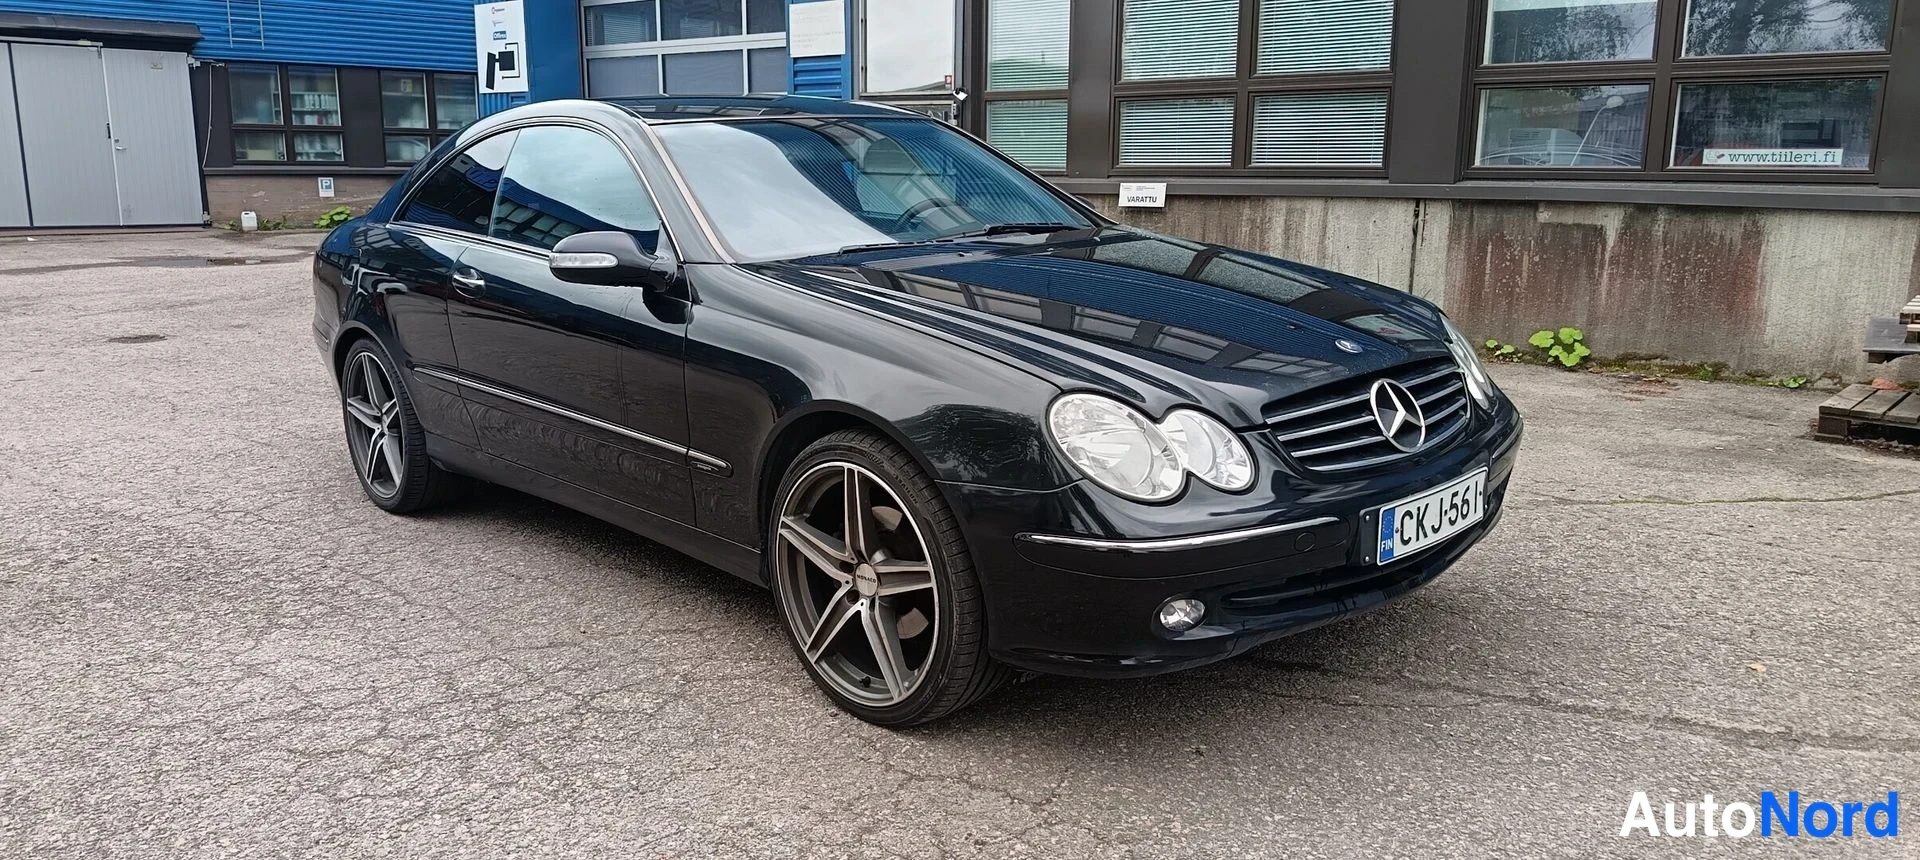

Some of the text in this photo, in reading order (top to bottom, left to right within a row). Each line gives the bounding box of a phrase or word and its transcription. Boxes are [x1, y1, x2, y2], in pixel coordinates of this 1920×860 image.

[1728, 151, 1836, 163] www.tiileri.fi
[322, 180, 330, 189] P
[1400, 481, 1479, 546] CKJ-561
[1381, 538, 1393, 553] FIN
